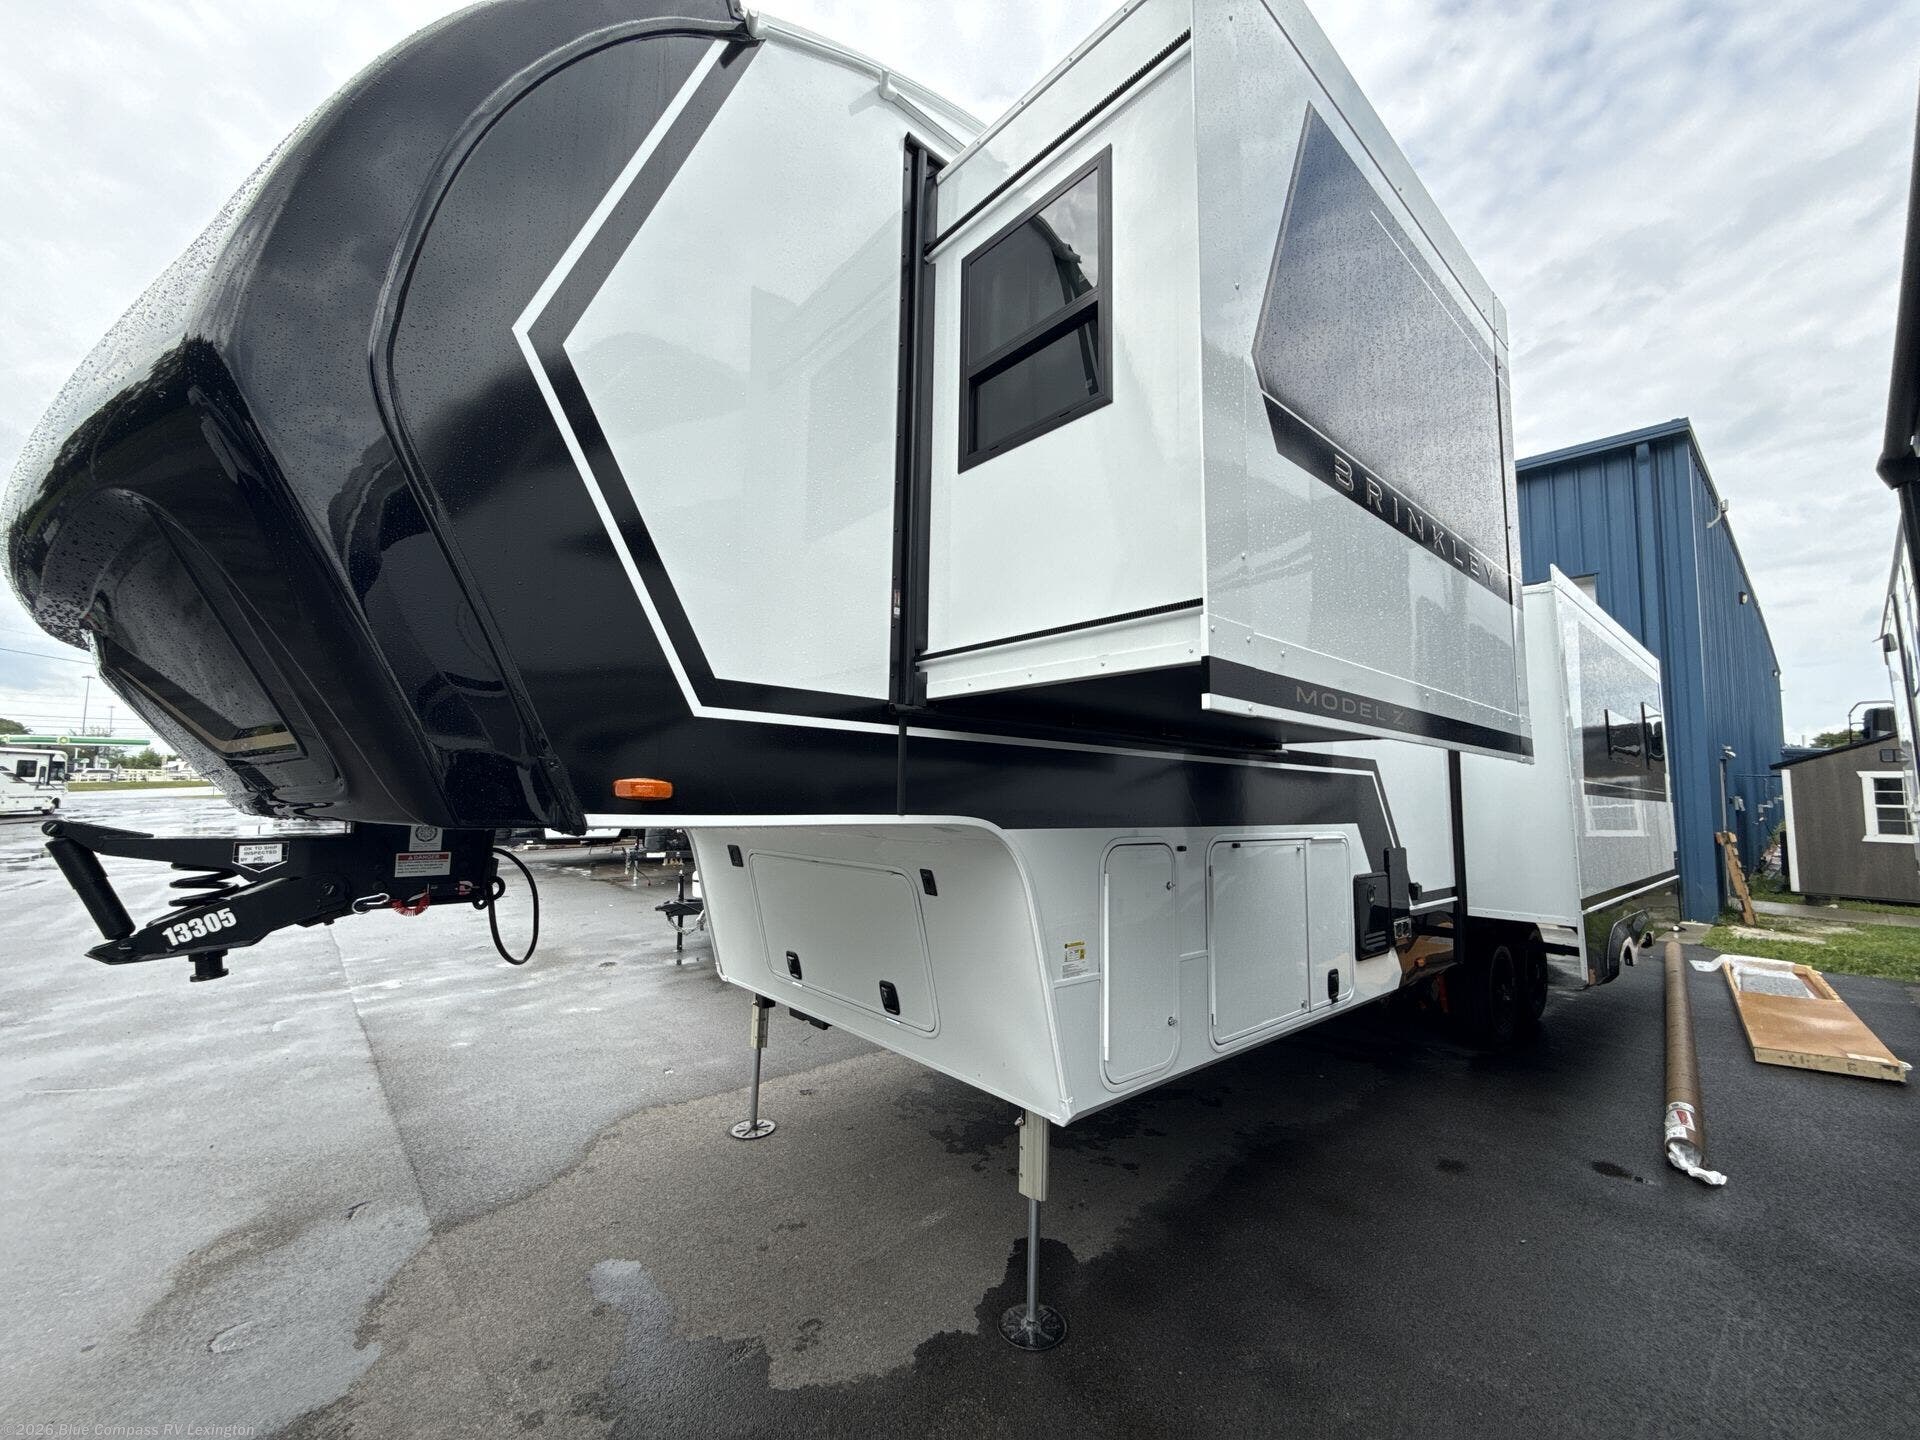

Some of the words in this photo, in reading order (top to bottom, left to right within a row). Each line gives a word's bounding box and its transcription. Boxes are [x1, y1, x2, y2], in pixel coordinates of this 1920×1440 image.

[1333, 453, 1495, 587] BRINKLEY
[1296, 686, 1387, 721] MODEL
[1392, 710, 1406, 726] Z
[162, 908, 237, 946] 13305
